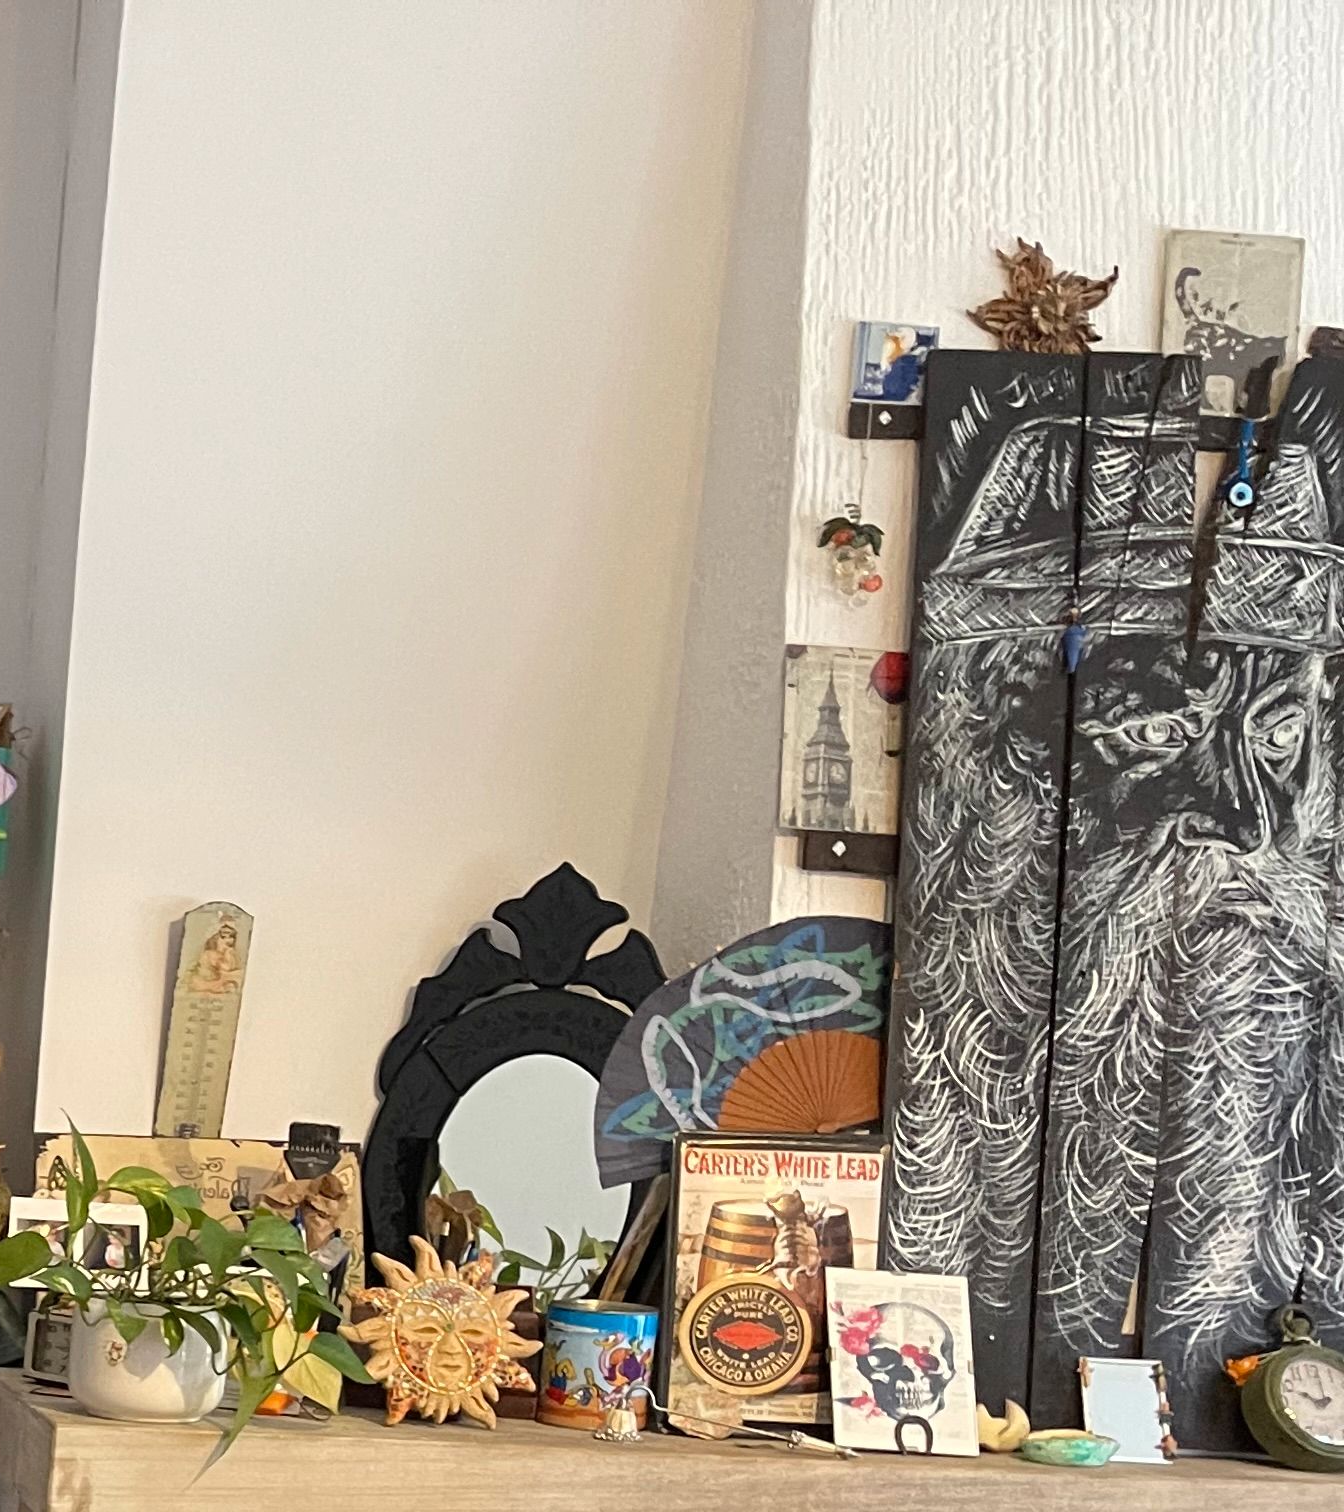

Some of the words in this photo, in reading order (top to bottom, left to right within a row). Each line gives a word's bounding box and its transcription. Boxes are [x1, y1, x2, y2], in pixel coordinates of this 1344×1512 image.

[684, 1149, 770, 1177] CARTER'S
[773, 1151, 831, 1179] WHITE
[836, 1154, 880, 1181] LEAD
[695, 1295, 727, 1339] CARTER
[727, 1288, 769, 1302] WHITE
[769, 1296, 795, 1324] LEAD
[724, 1301, 775, 1316] STRICTLY
[699, 1347, 743, 1381] CHICAGO
[754, 1351, 792, 1380] OMAHA
